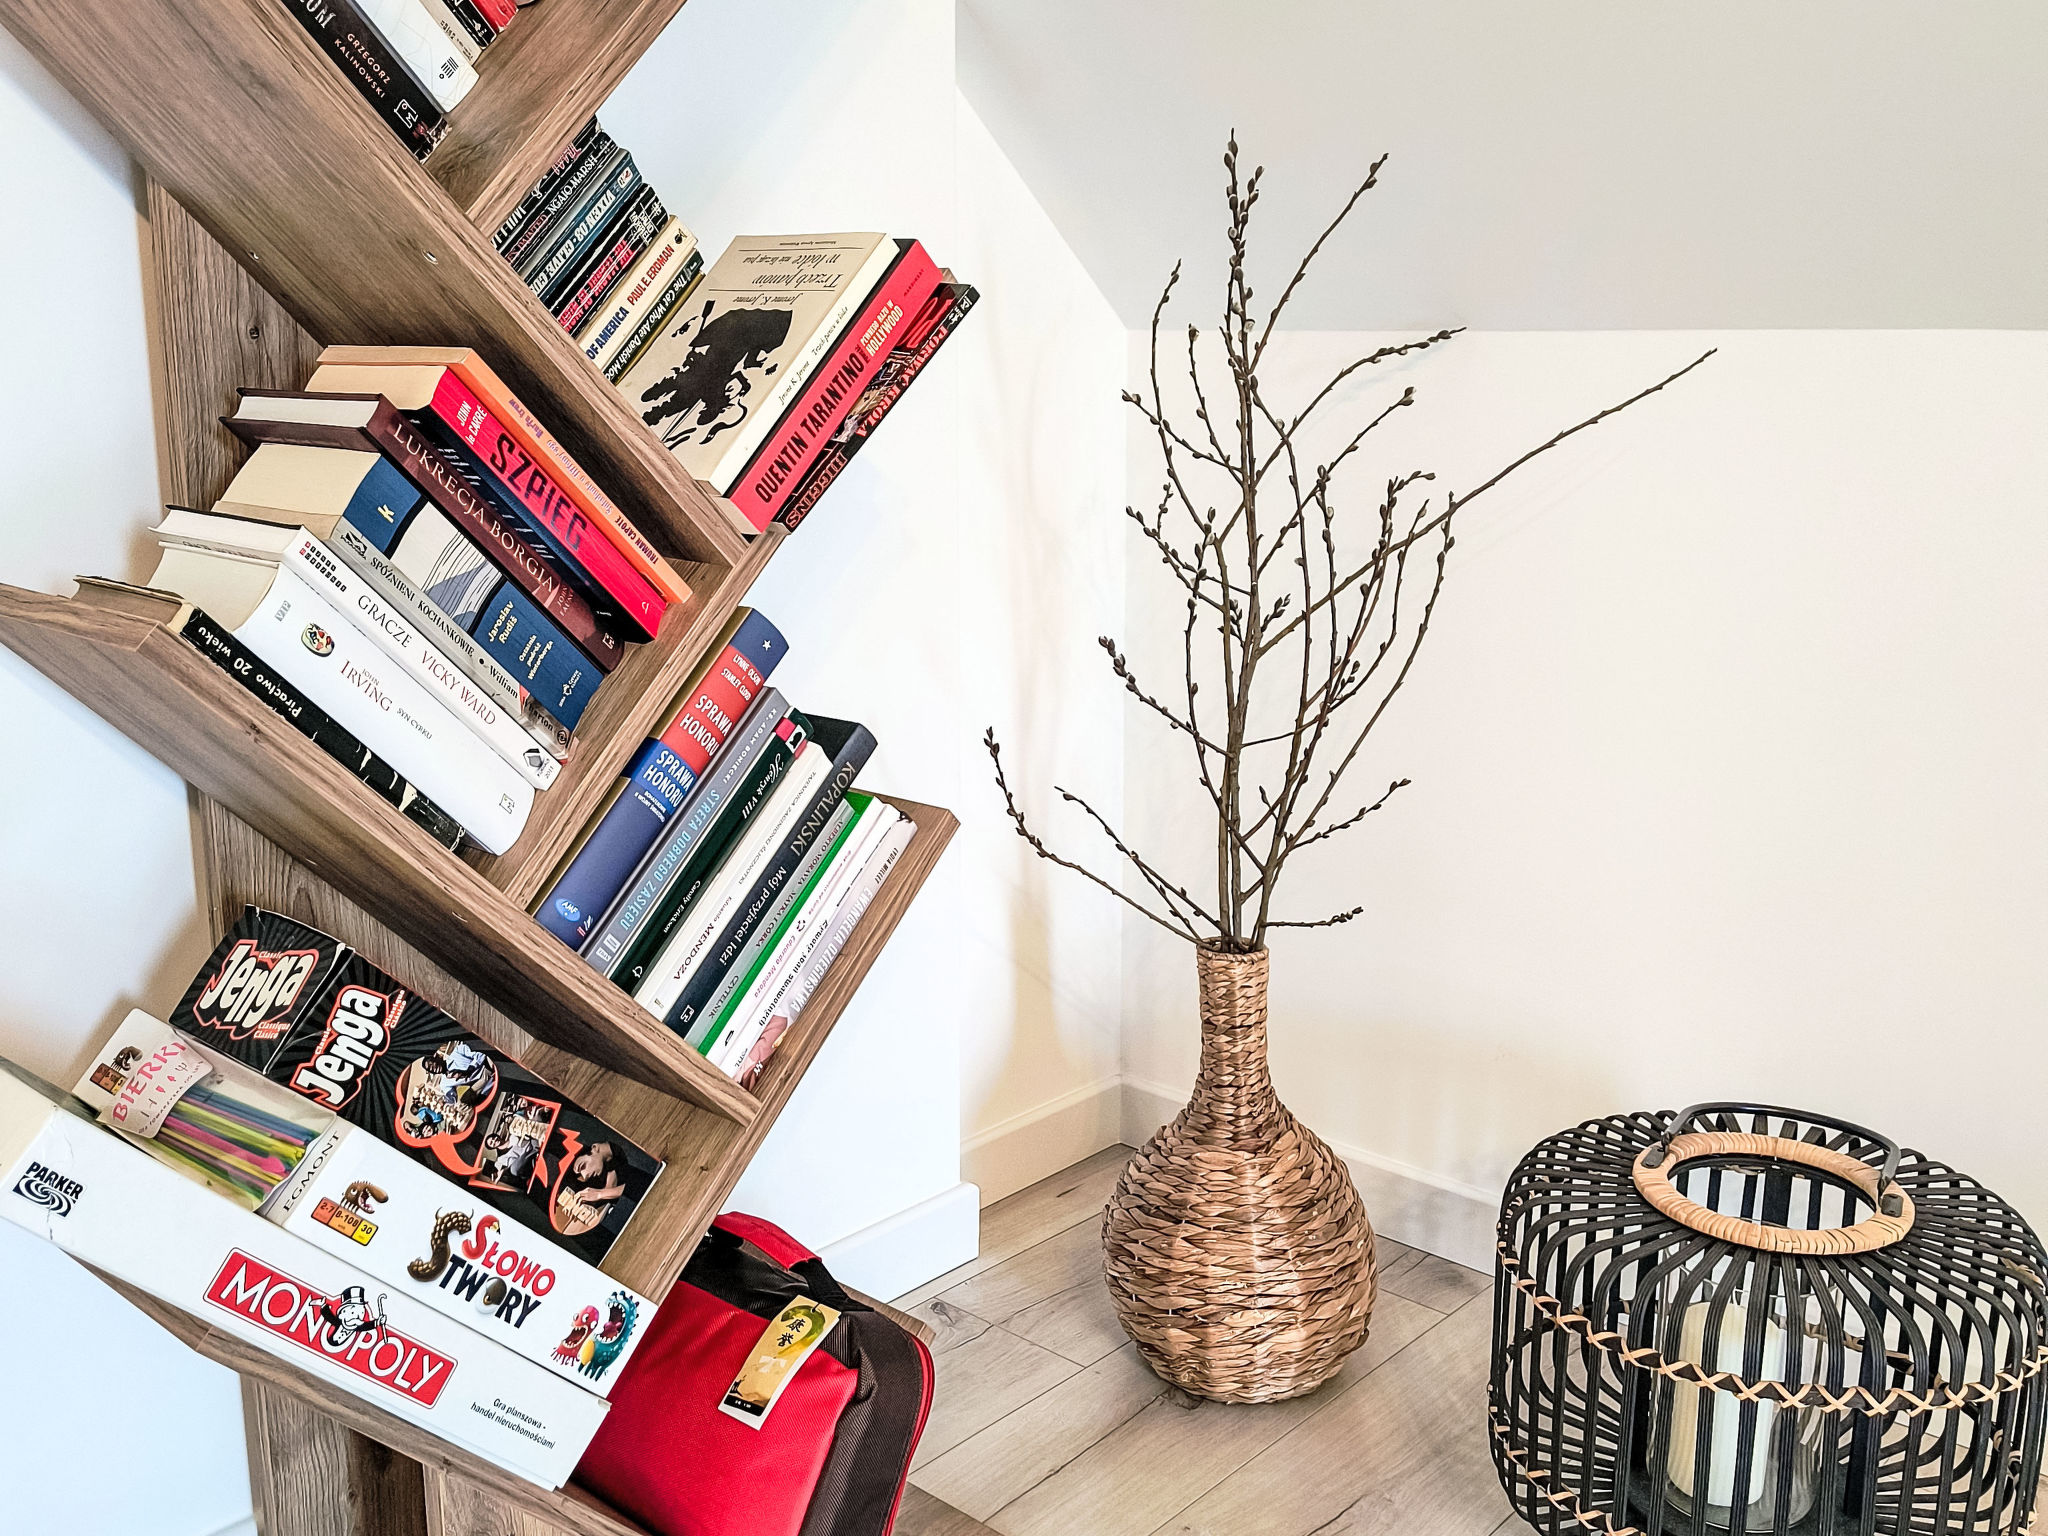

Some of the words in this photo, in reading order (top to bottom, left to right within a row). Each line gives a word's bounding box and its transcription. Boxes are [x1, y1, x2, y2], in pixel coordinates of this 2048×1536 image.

[299, 0, 337, 29] OM
[332, 35, 386, 100] KALINOWSKI
[345, 30, 391, 86] GRZEGORZ
[542, 180, 575, 216] NGAIO
[568, 152, 599, 189] MARSH
[582, 188, 617, 228] VIXEN
[638, 211, 654, 234] DAVID
[542, 237, 577, 278] CLIVE
[644, 243, 676, 280] ERDMAN
[751, 263, 802, 288] panów
[625, 281, 647, 305] PAUL
[660, 289, 678, 307] Cat
[671, 274, 690, 293] The
[732, 292, 763, 304] Jerome
[771, 292, 802, 304] Jerome
[795, 269, 843, 290] Trzech
[592, 305, 630, 348] AMERICA
[635, 319, 655, 339] Ate
[647, 302, 668, 324] Who
[857, 319, 881, 347] PEWNEGO
[874, 305, 890, 323] RAZU
[884, 298, 896, 309] W
[863, 303, 906, 357] HOLLYWOOD
[584, 342, 602, 360] OF
[615, 334, 643, 366] Danish
[896, 322, 950, 388] PORWAĆ
[457, 401, 471, 427] JOHN
[469, 404, 488, 436] CARRÉ
[750, 429, 812, 504] QUENTIN
[796, 350, 869, 440] TARANTINO
[853, 383, 903, 440] KRÓLA
[389, 422, 492, 527] LUKRECJA
[484, 519, 560, 593] BORGIA
[488, 431, 588, 552] SZPIEG
[782, 450, 850, 531] HIGGINS
[614, 515, 637, 541] CAPOTE
[633, 537, 659, 565] TRUMAN
[368, 555, 418, 602] SPÓŹNIENI
[414, 599, 477, 658] KOCHANKOWIE
[485, 664, 521, 699] William
[486, 599, 515, 642] Jaroslav
[497, 614, 518, 643] Rudiš
[194, 624, 233, 660] wieku
[353, 592, 415, 648] GRACZE
[415, 649, 462, 692] VICKY
[454, 685, 500, 727] WARD
[517, 633, 537, 662] Ostatnia
[526, 639, 554, 680] Winterberga
[231, 655, 253, 676] 20
[360, 667, 381, 687] JOHN
[719, 666, 742, 689] STANLEY
[731, 653, 750, 673] LYNNE
[251, 671, 304, 718] Piractwo
[337, 658, 397, 714] IRVING
[394, 706, 412, 723] SYN
[408, 717, 434, 741] CYRKU
[693, 692, 732, 737] SPRAWA
[747, 720, 767, 746] ADAM
[678, 711, 719, 757] HONORU
[654, 747, 694, 792] SPRAWA
[720, 743, 751, 785] BONIECKI
[642, 763, 683, 808] HONORU
[789, 769, 816, 808] TAJEMNICA
[686, 787, 722, 832] STREFA
[738, 794, 760, 819] VIII
[818, 818, 845, 853] ALBERTO
[650, 827, 693, 883] DOBREGO
[795, 850, 822, 887] MORAVIA
[871, 862, 890, 885] MILLET
[884, 846, 899, 864] LYDIA
[680, 878, 702, 906] Carolly
[765, 864, 788, 891] Mój
[616, 878, 658, 932] ZASIĘGU
[661, 903, 686, 935] Erickson
[730, 886, 773, 944] przyjaciel
[774, 889, 797, 918] MATKA
[830, 885, 875, 945] EWANGELIA
[672, 920, 716, 983] MENDOZA
[716, 941, 738, 966] Idzi
[754, 920, 777, 950] CÓRKA
[258, 950, 284, 960] Classic
[199, 944, 314, 1029] Jenga
[707, 973, 740, 1020] CZYTELNIK
[257, 1021, 291, 1031] Classique
[383, 989, 405, 1027] Classique
[253, 1030, 279, 1040] Clásico
[295, 989, 385, 1106] Jenga
[314, 1026, 331, 1055] Classic
[112, 1042, 188, 1122] BIERKI
[25, 1161, 84, 1200] PARKER
[283, 1130, 340, 1213] EGMONT
[360, 1223, 373, 1235] 30
[461, 1215, 556, 1297] SŁOWO
[220, 1260, 444, 1394] MONOPOLY
[470, 1401, 496, 1420] handel
[494, 1412, 555, 1450] nieruchomościami
[492, 1397, 507, 1411] Gra
[505, 1404, 543, 1430] planszowa
